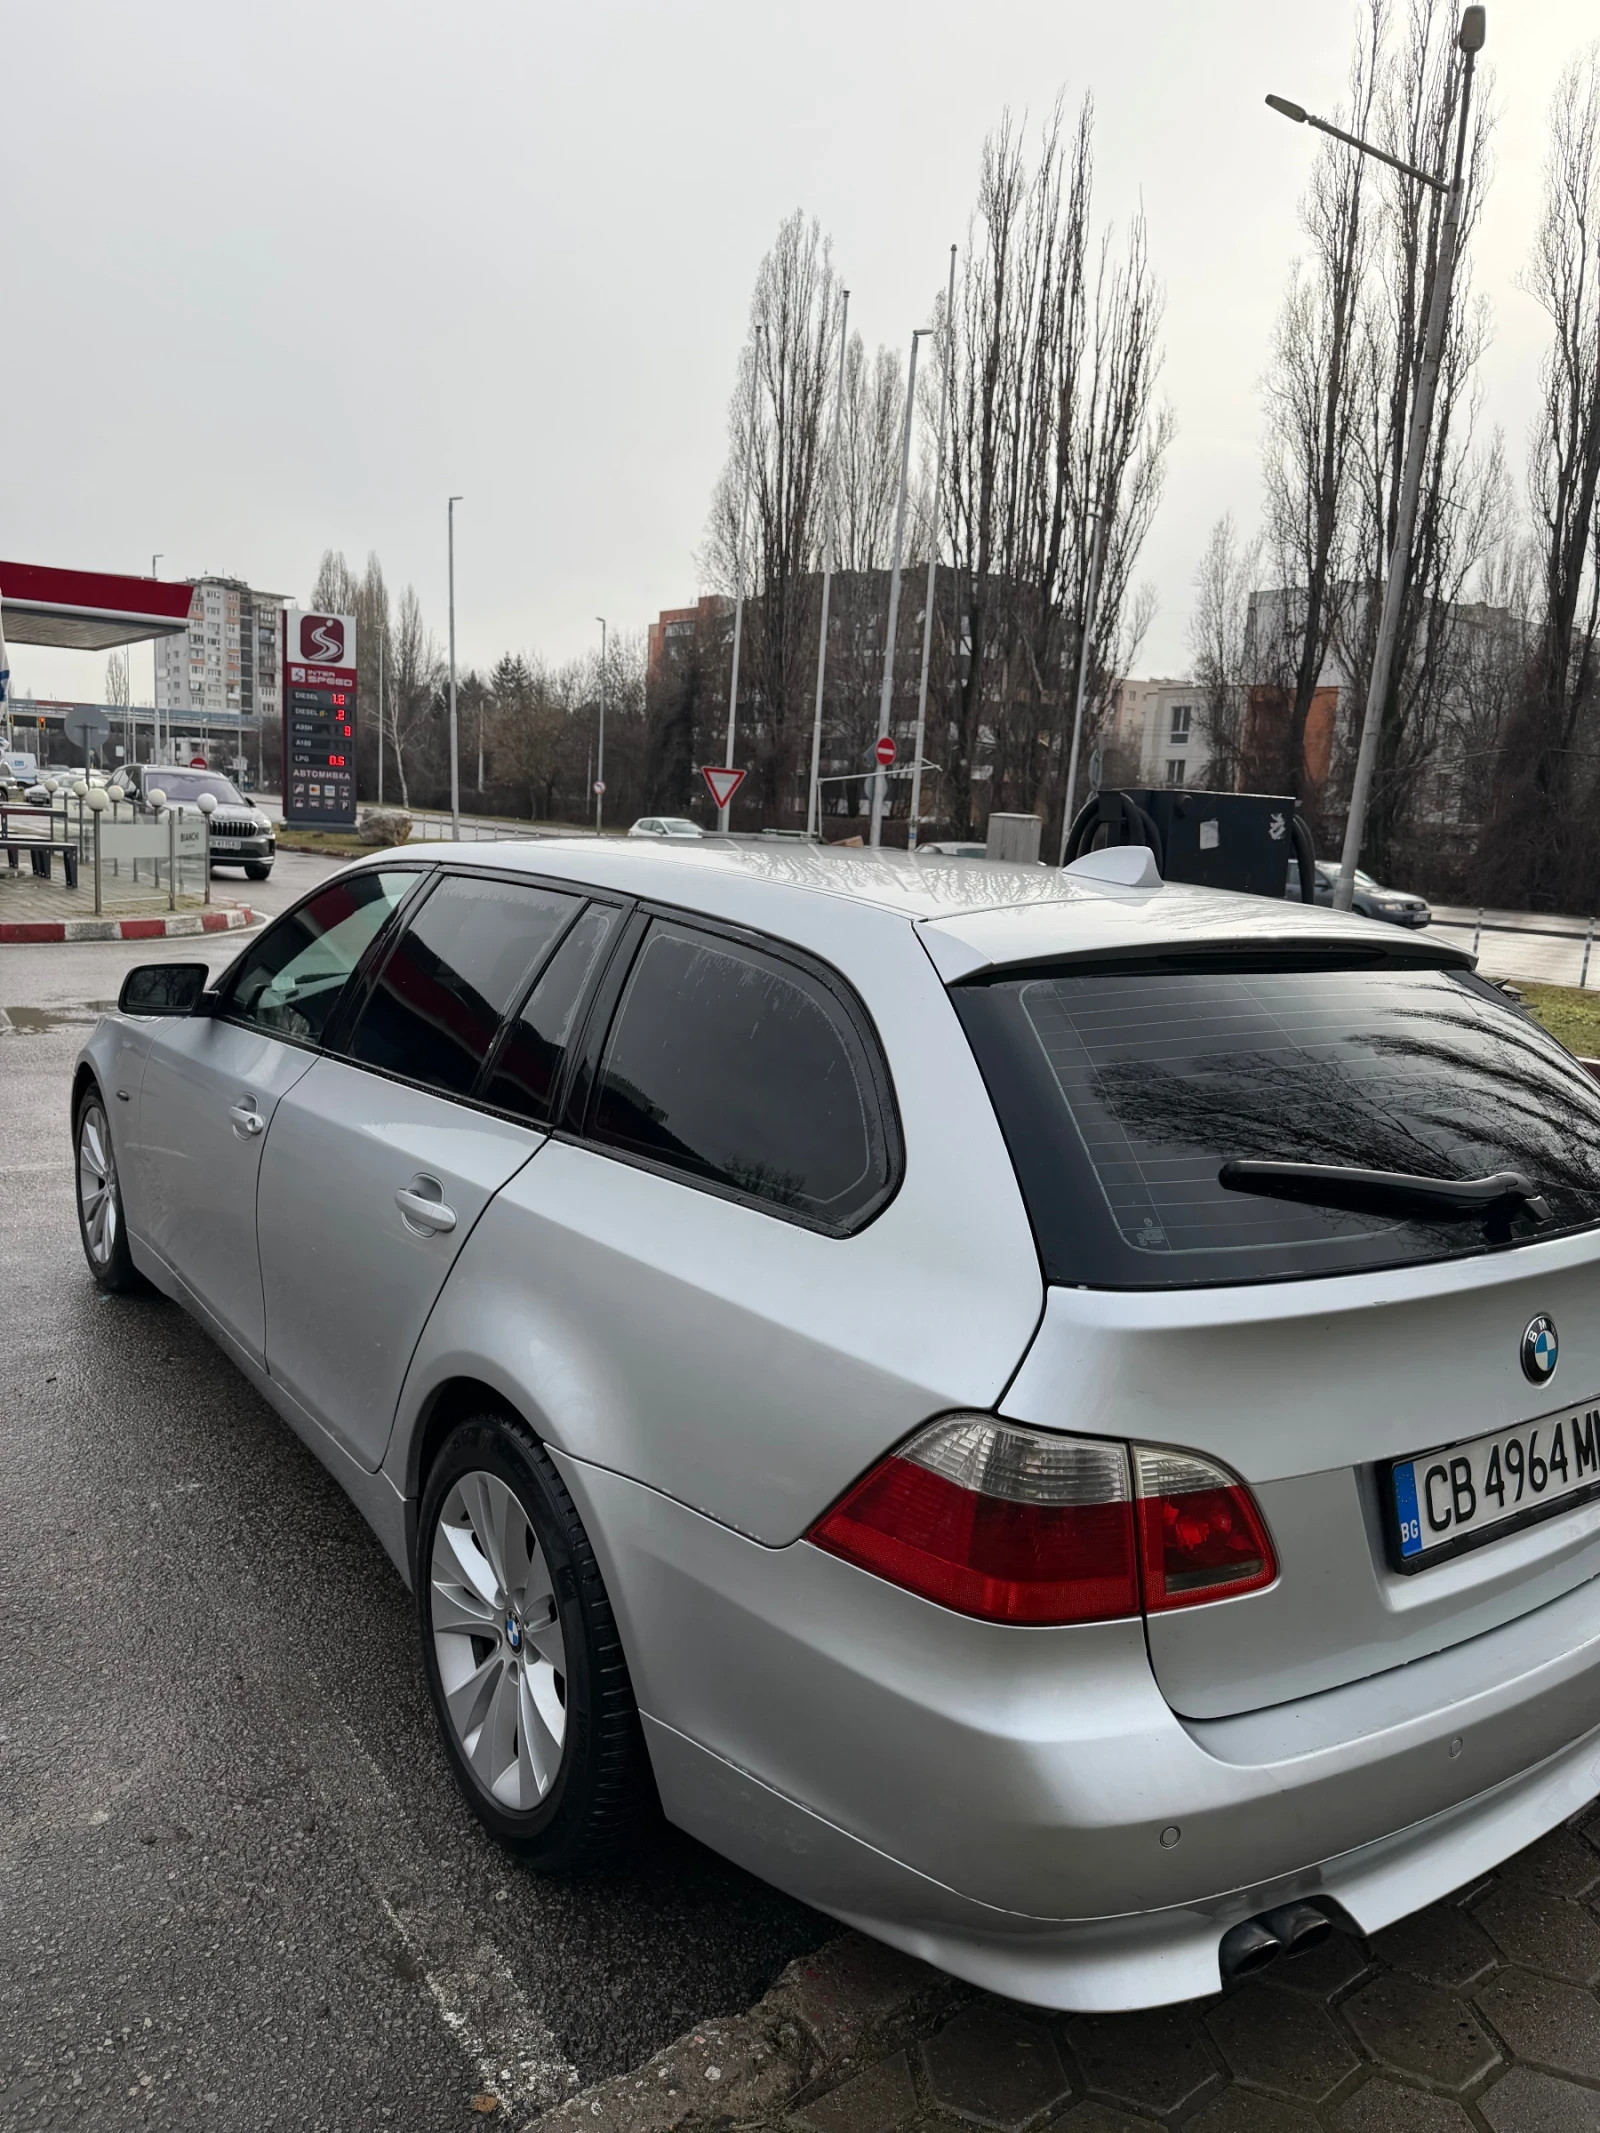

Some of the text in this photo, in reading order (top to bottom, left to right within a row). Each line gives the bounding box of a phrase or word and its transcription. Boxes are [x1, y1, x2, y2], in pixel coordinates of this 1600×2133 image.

[307, 669, 336, 678] INTER
[307, 676, 353, 687] SPEED
[295, 691, 318, 701] DIESEL
[295, 707, 318, 717] DIESEL
[294, 755, 309, 763] LPG
[293, 768, 351, 780] АВТОМИВКА
[1424, 1455, 1477, 1532] CB
[1484, 1421, 1568, 1508] 4964
[1400, 1518, 1420, 1544] BG
